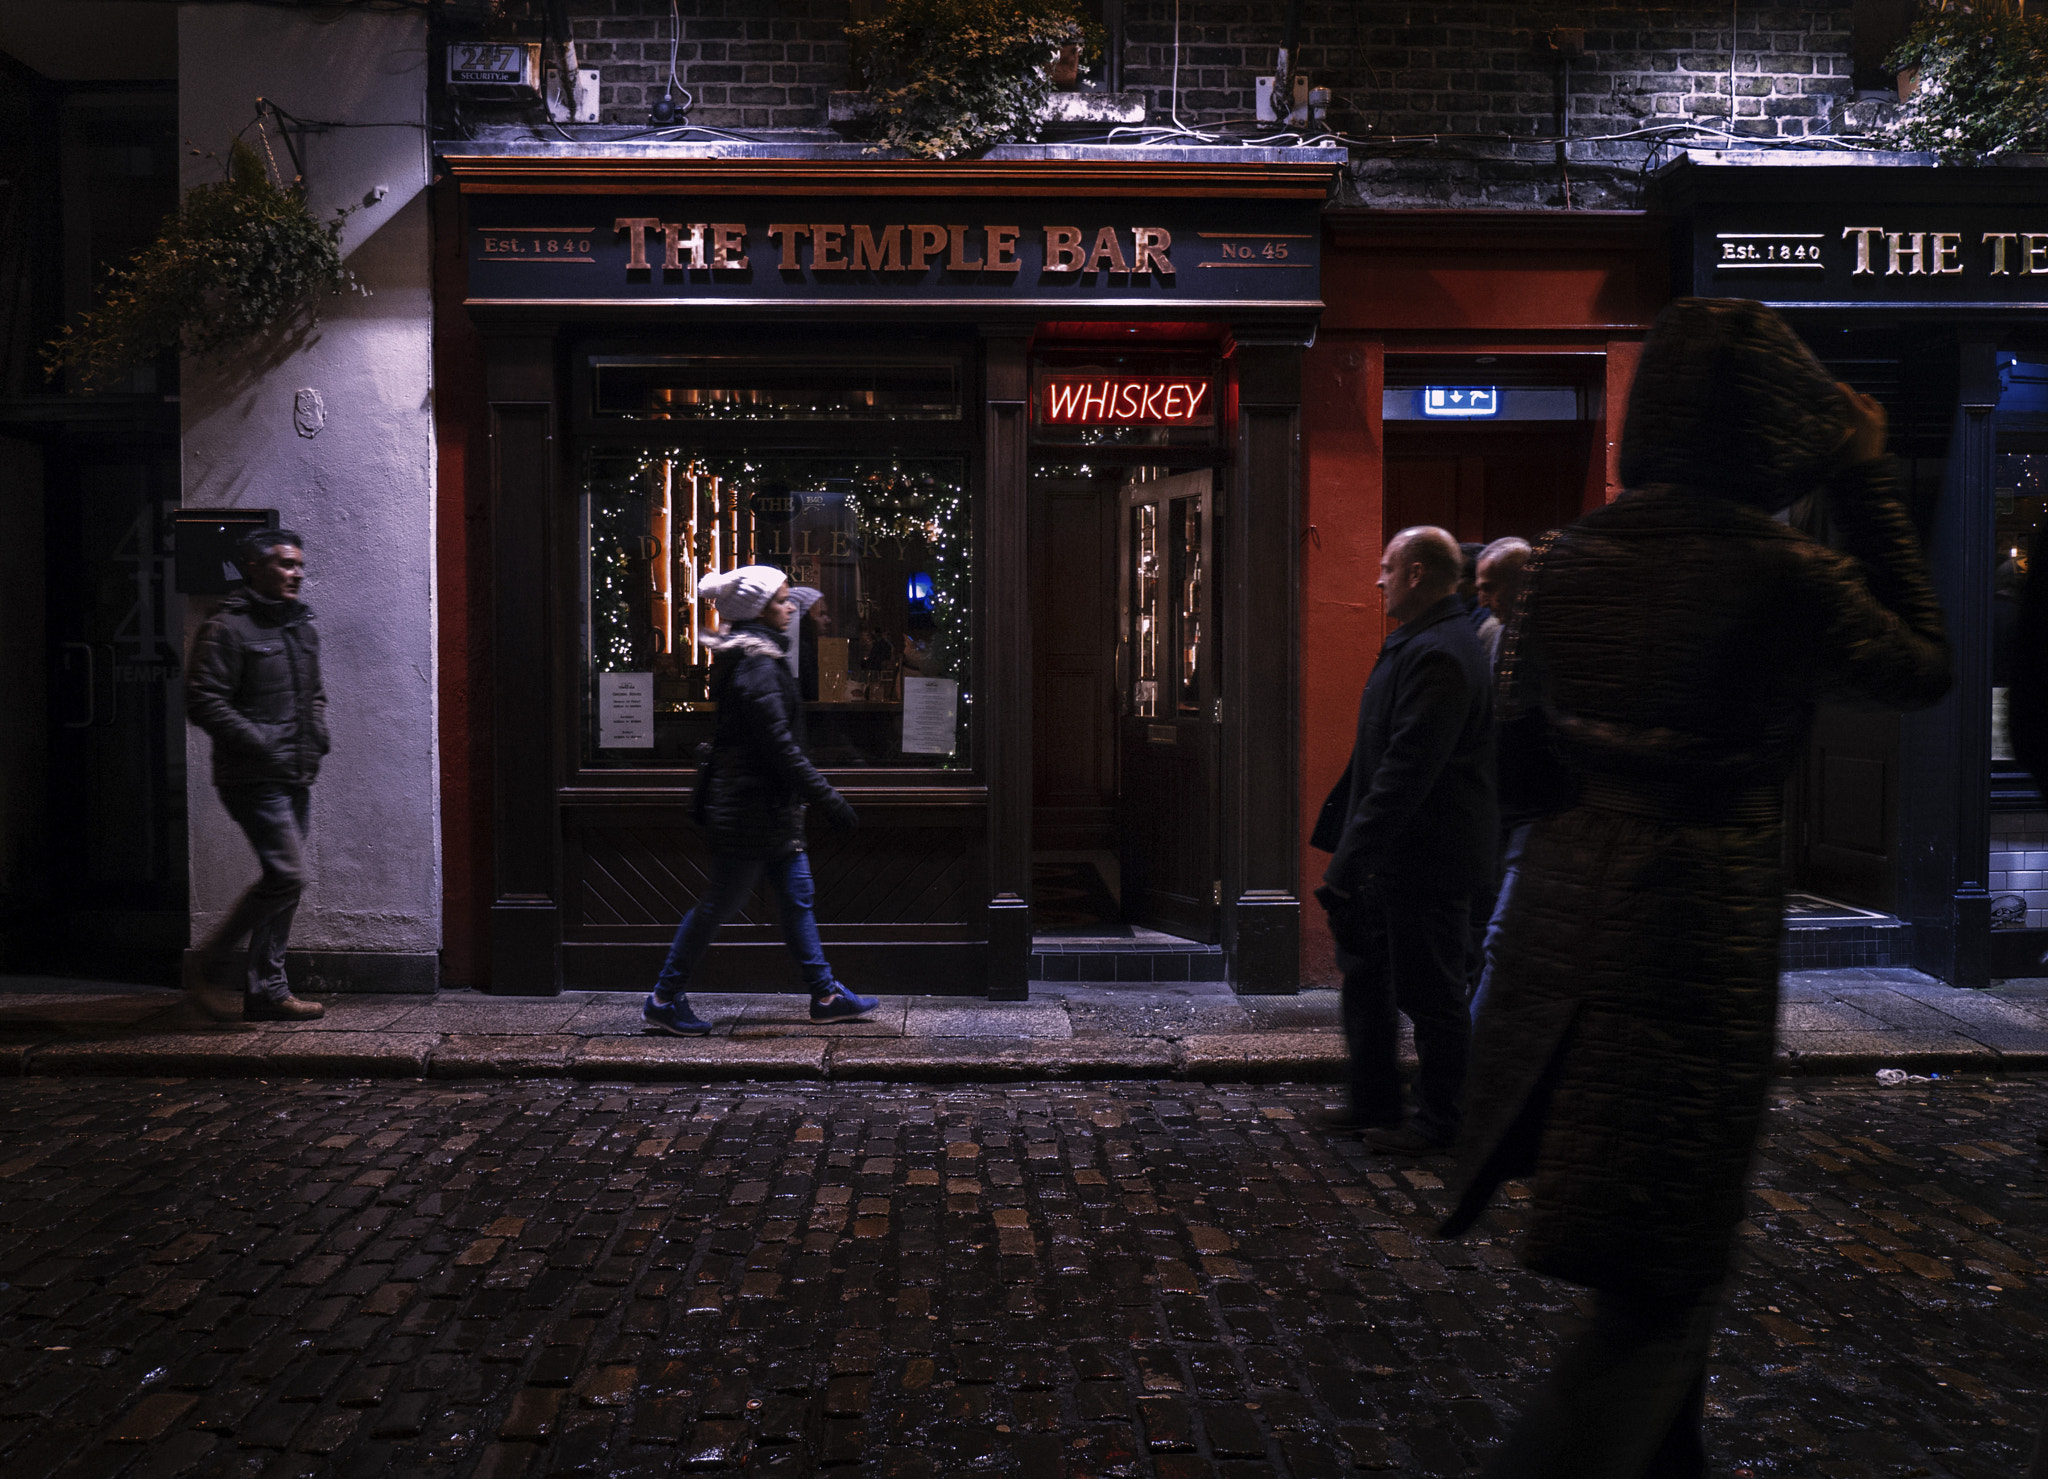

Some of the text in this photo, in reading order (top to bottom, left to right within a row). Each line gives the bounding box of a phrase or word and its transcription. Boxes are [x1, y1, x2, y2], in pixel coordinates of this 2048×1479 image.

[460, 72, 510, 81] SECURITY.ie
[484, 237, 591, 254] Est. 1840
[613, 217, 1176, 274] THE TEMPLE BAR
[1221, 241, 1289, 260] No. 45
[1721, 243, 1821, 260] Est. 1840
[1842, 226, 1964, 276] THE
[1050, 381, 1207, 421] WHISKEY
[756, 497, 795, 512] THE
[637, 530, 915, 561] DISTILLERY
